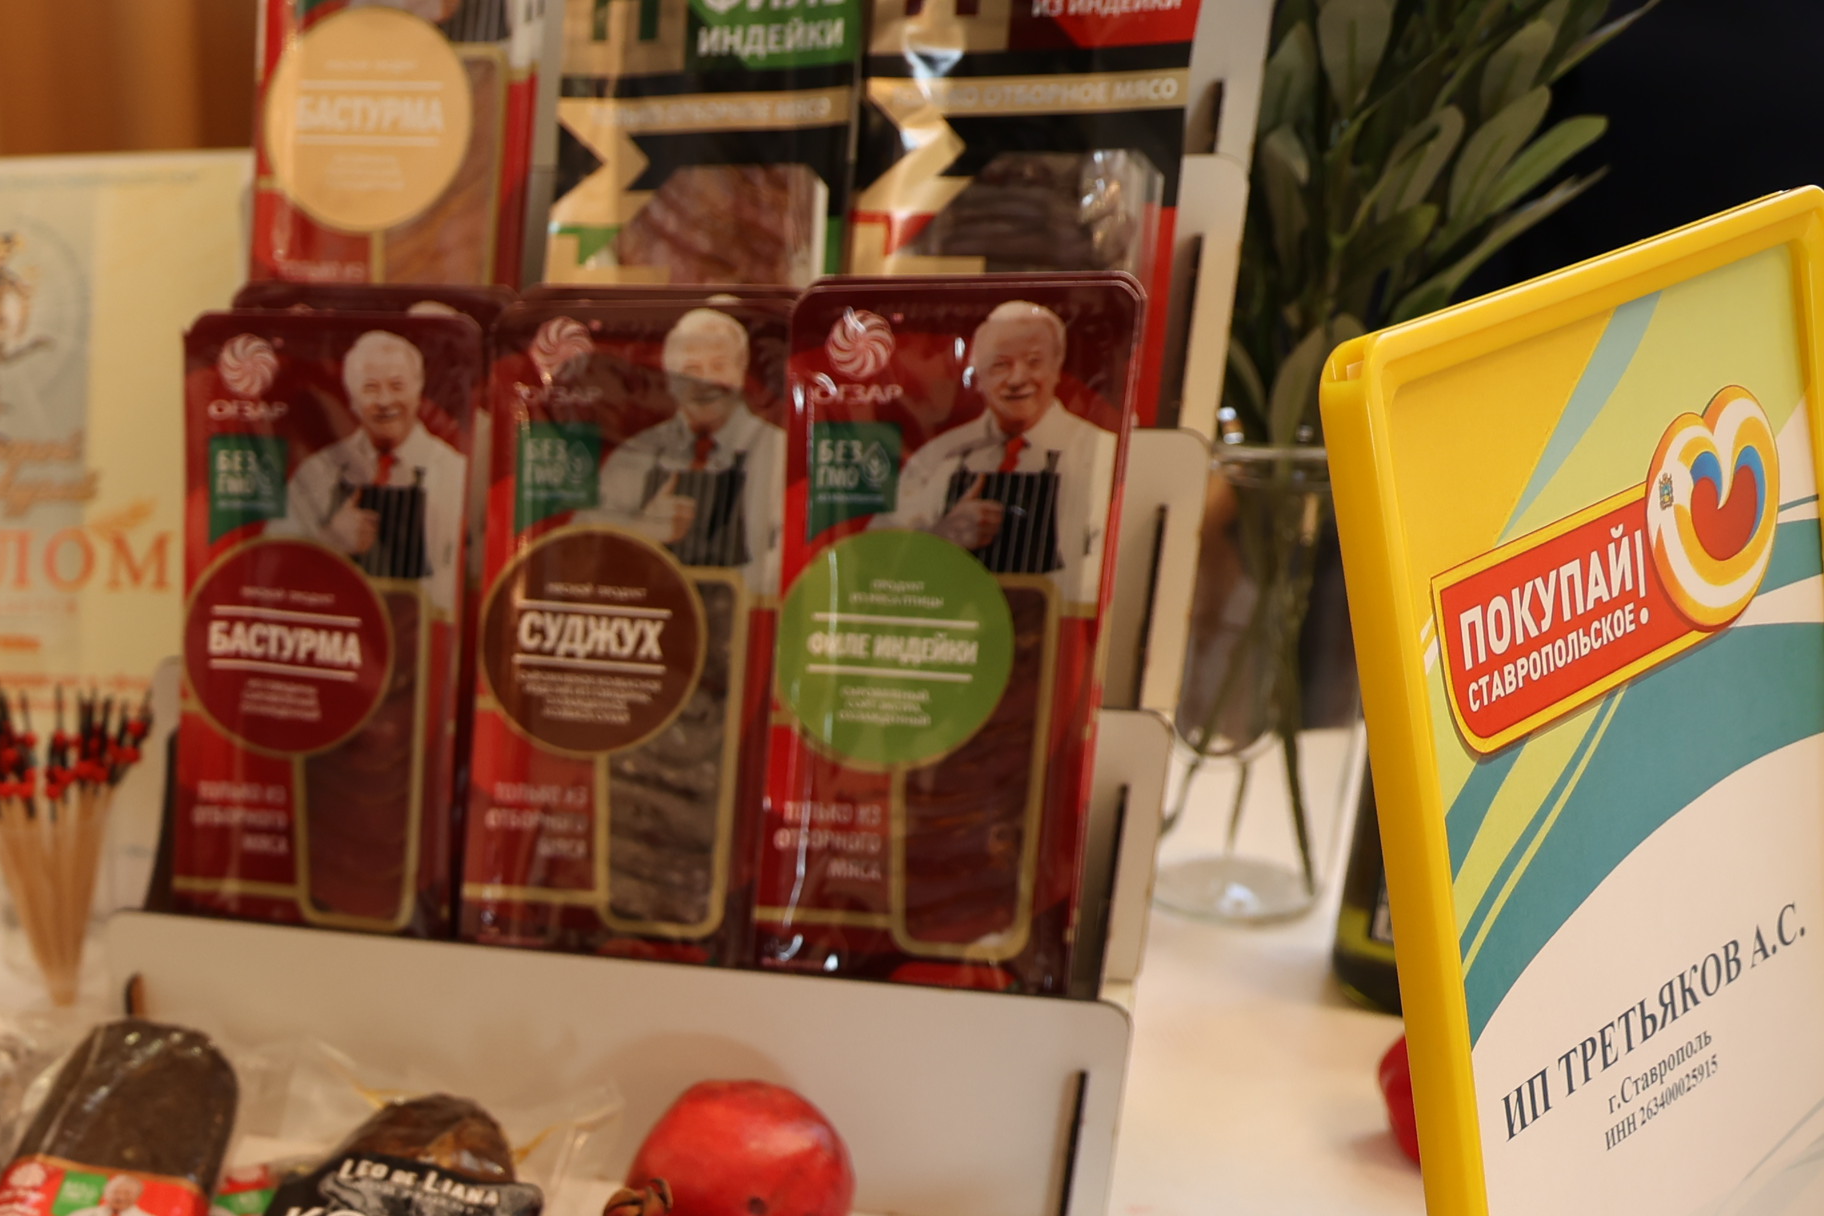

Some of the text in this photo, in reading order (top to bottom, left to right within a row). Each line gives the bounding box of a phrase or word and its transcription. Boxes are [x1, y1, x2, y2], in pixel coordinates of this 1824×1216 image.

[698, 18, 845, 57] ИНДЕЙКИ
[296, 94, 445, 133] БАСТУРМА
[984, 81, 1109, 107] ОТБОРНОЕ
[817, 438, 863, 466] БЕЗ
[816, 463, 859, 491] ГМО
[208, 619, 362, 669] БАСТУРМА
[517, 610, 664, 661] СУДЖУХ
[807, 631, 979, 666] ФИЛЕ ИНДЕЙКИ
[1467, 603, 1637, 713] СТАВРОПОЛЬСКОЕ
[1501, 900, 1807, 1143] ИП ТРЕТЬЯКОВ А.С.
[1607, 1029, 1713, 1115] г.Ставрополь
[1604, 1109, 1638, 1152] ИНН
[339, 1158, 390, 1180] LEO
[424, 1169, 501, 1207] LIANA
